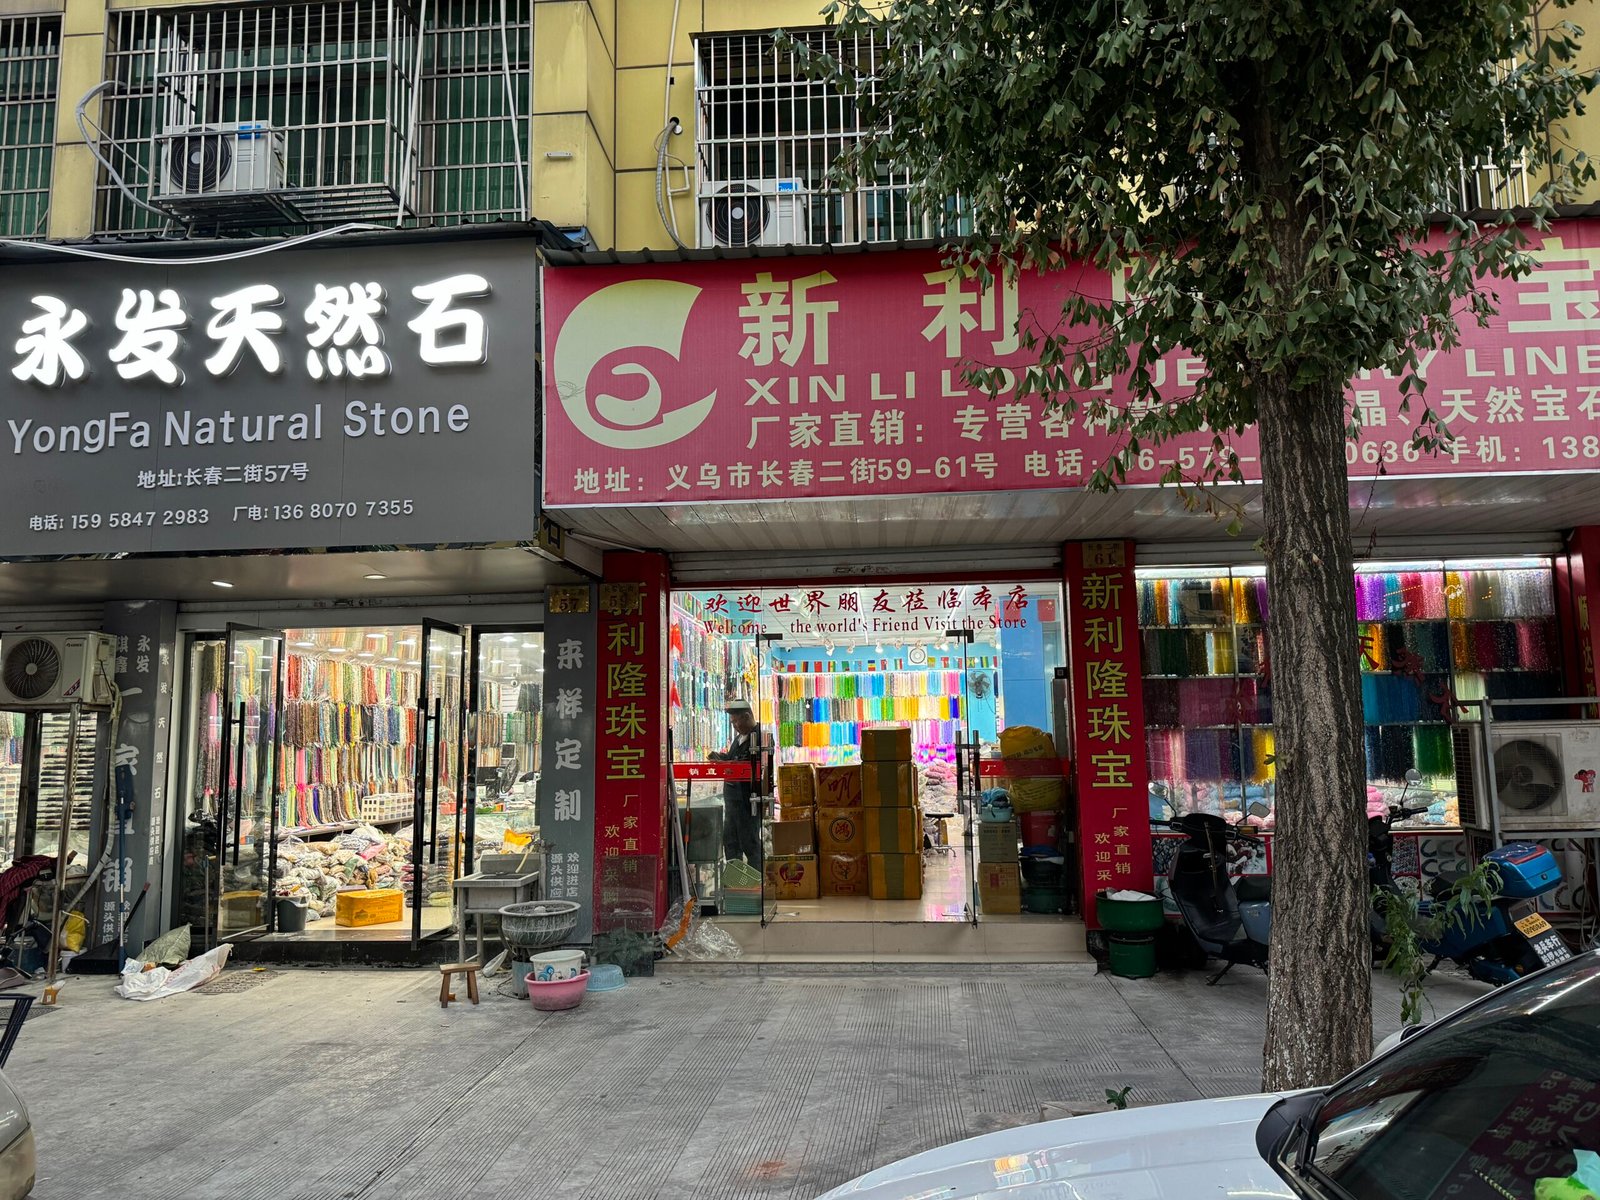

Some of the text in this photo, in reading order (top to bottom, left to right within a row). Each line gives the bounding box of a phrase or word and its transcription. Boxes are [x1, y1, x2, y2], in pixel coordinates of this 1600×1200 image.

[11, 274, 490, 386] 永发天然石
[744, 375, 846, 406] XIN
[870, 372, 916, 400] LI
[1465, 344, 1600, 378] LINE
[7, 400, 471, 454] YongFa Natural Stone
[665, 451, 998, 491] 义乌市长春二街59-61号
[71, 513, 102, 530] 159
[108, 511, 157, 528] 5847
[162, 508, 210, 526] 2983
[273, 503, 304, 520] 136
[310, 501, 358, 518] 8070
[365, 498, 414, 516] 7355
[704, 585, 1028, 616] 欢迎世界朋友莅临本店
[704, 613, 1027, 635] Welcome the world's Friend Visit the Store
[136, 634, 151, 673] 永发
[1081, 572, 1133, 788] 新利隆珠宝
[555, 638, 585, 822] 来样定制
[622, 794, 639, 873] 厂家直销
[1094, 833, 1112, 893] 欢迎采
[1112, 807, 1132, 875] 厂家直销
